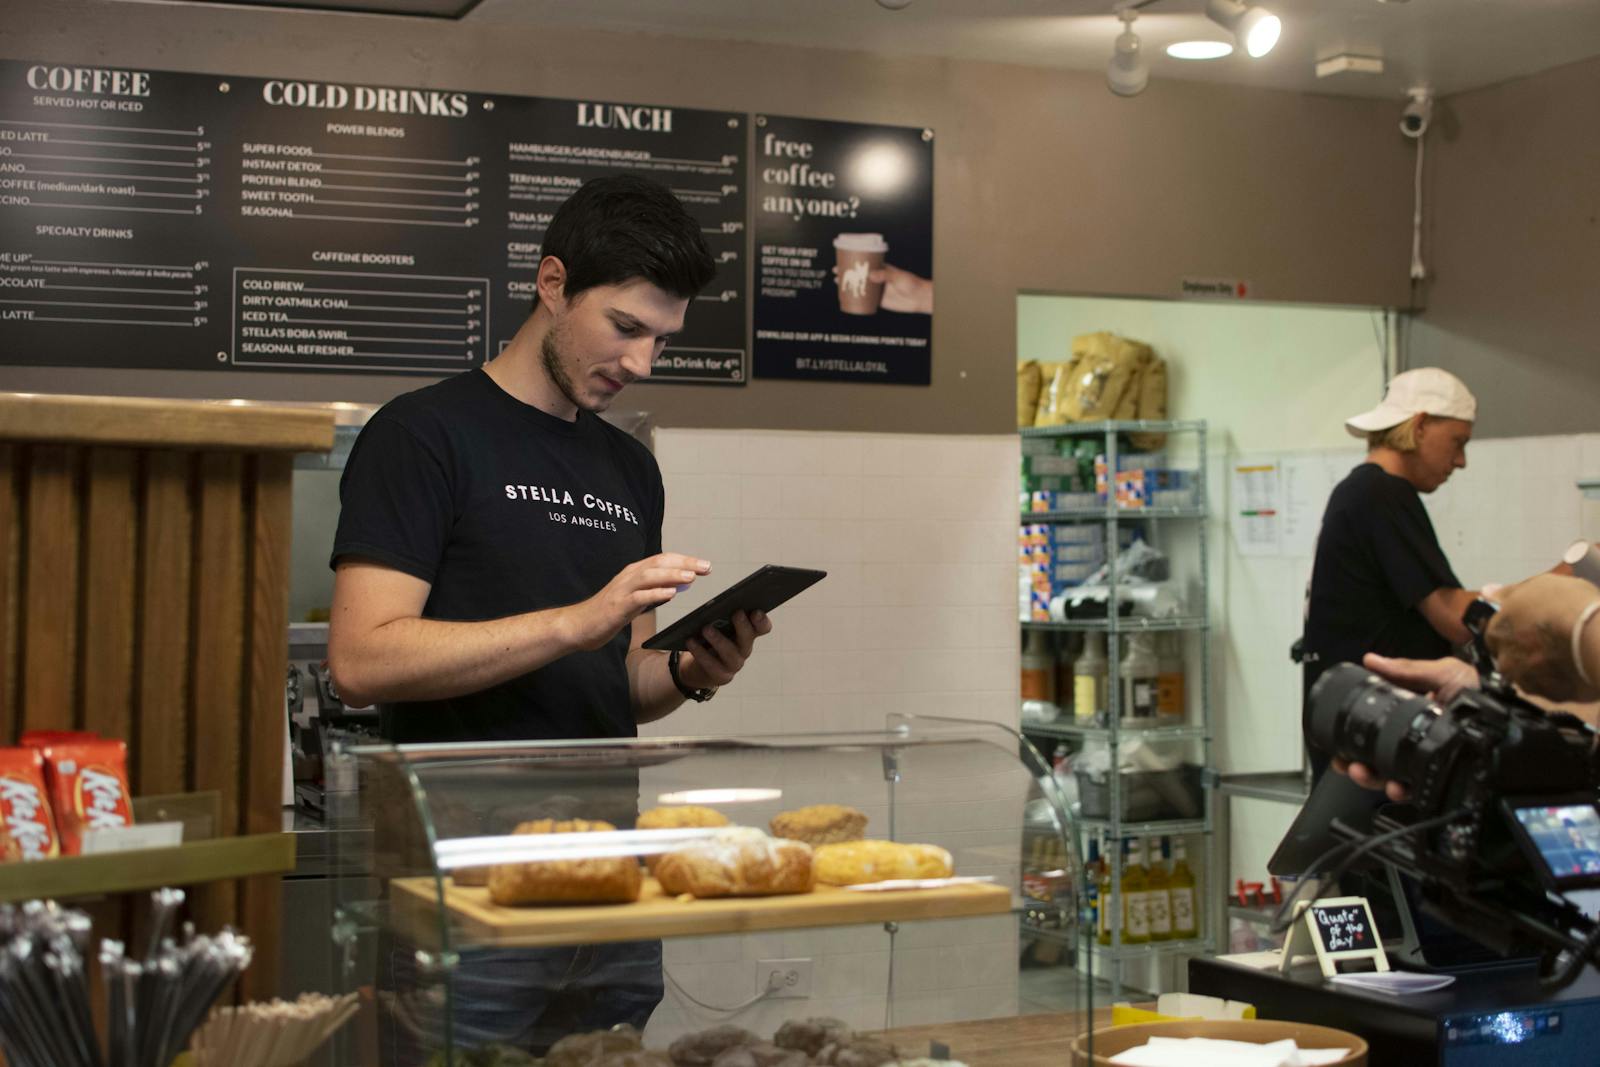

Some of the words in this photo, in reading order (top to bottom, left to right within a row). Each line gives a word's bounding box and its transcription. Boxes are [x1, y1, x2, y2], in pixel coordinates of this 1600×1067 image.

[27, 65, 150, 97] COFFEE
[34, 96, 74, 108] SERVED
[76, 99, 99, 109] HOT
[101, 101, 116, 110] OR
[118, 102, 143, 112] ICED
[263, 81, 348, 109] COLD
[355, 87, 468, 117] DRINKS
[577, 103, 672, 132] LUNCH
[17, 132, 49, 142] LATTE
[327, 123, 365, 136] POWER
[366, 126, 405, 137] BLENDS
[243, 143, 275, 154] SUPER
[277, 145, 312, 156] FOODS
[764, 133, 813, 158] free
[243, 159, 285, 170] INSTANT
[287, 161, 322, 172] DETOX
[242, 175, 286, 186] PROTEIN
[288, 177, 322, 188] BLEND
[509, 173, 552, 185] TERIYAKI
[553, 176, 584, 187] BOWL
[763, 164, 835, 188] coffee
[38, 181, 104, 194] (medium/dark
[107, 185, 135, 197] roast)
[242, 190, 276, 201] SWEET
[278, 192, 314, 203] TOOTH
[242, 206, 293, 218] SEASONAL
[763, 196, 860, 221] anyone?
[508, 212, 535, 222] TUNA
[36, 225, 92, 237] SPECIALTY
[94, 228, 133, 239] DRINKS
[313, 251, 361, 263] CAFFEINE
[362, 253, 415, 265] BOOSTERS
[762, 256, 788, 266] COFFEE
[243, 280, 272, 290] COLD
[273, 281, 304, 291] BREW
[243, 295, 273, 306] DIRTY
[275, 297, 321, 308] OATMILK
[323, 300, 348, 309] CHAI
[3, 310, 35, 320] LATTE
[243, 312, 267, 321] ICED
[269, 313, 289, 322] TEA
[242, 327, 285, 338] STELLA'S
[287, 329, 316, 339] BOBA
[318, 330, 348, 340] SWIRL
[757, 330, 794, 341] DOWNLOAD
[795, 331, 808, 341] OUR
[810, 332, 823, 341] APP
[905, 337, 927, 347] TODAY
[242, 342, 295, 354] SEASONAL
[297, 345, 354, 356] REFRESHER
[673, 357, 704, 369] Drink
[706, 358, 721, 369] for
[505, 484, 574, 506] STELLA
[583, 494, 639, 525] COFFEE
[549, 512, 567, 523] LOS
[571, 516, 617, 532] ANGELES
[1330, 924, 1341, 936] of
[1345, 923, 1363, 934] the
[1329, 936, 1353, 950] day
